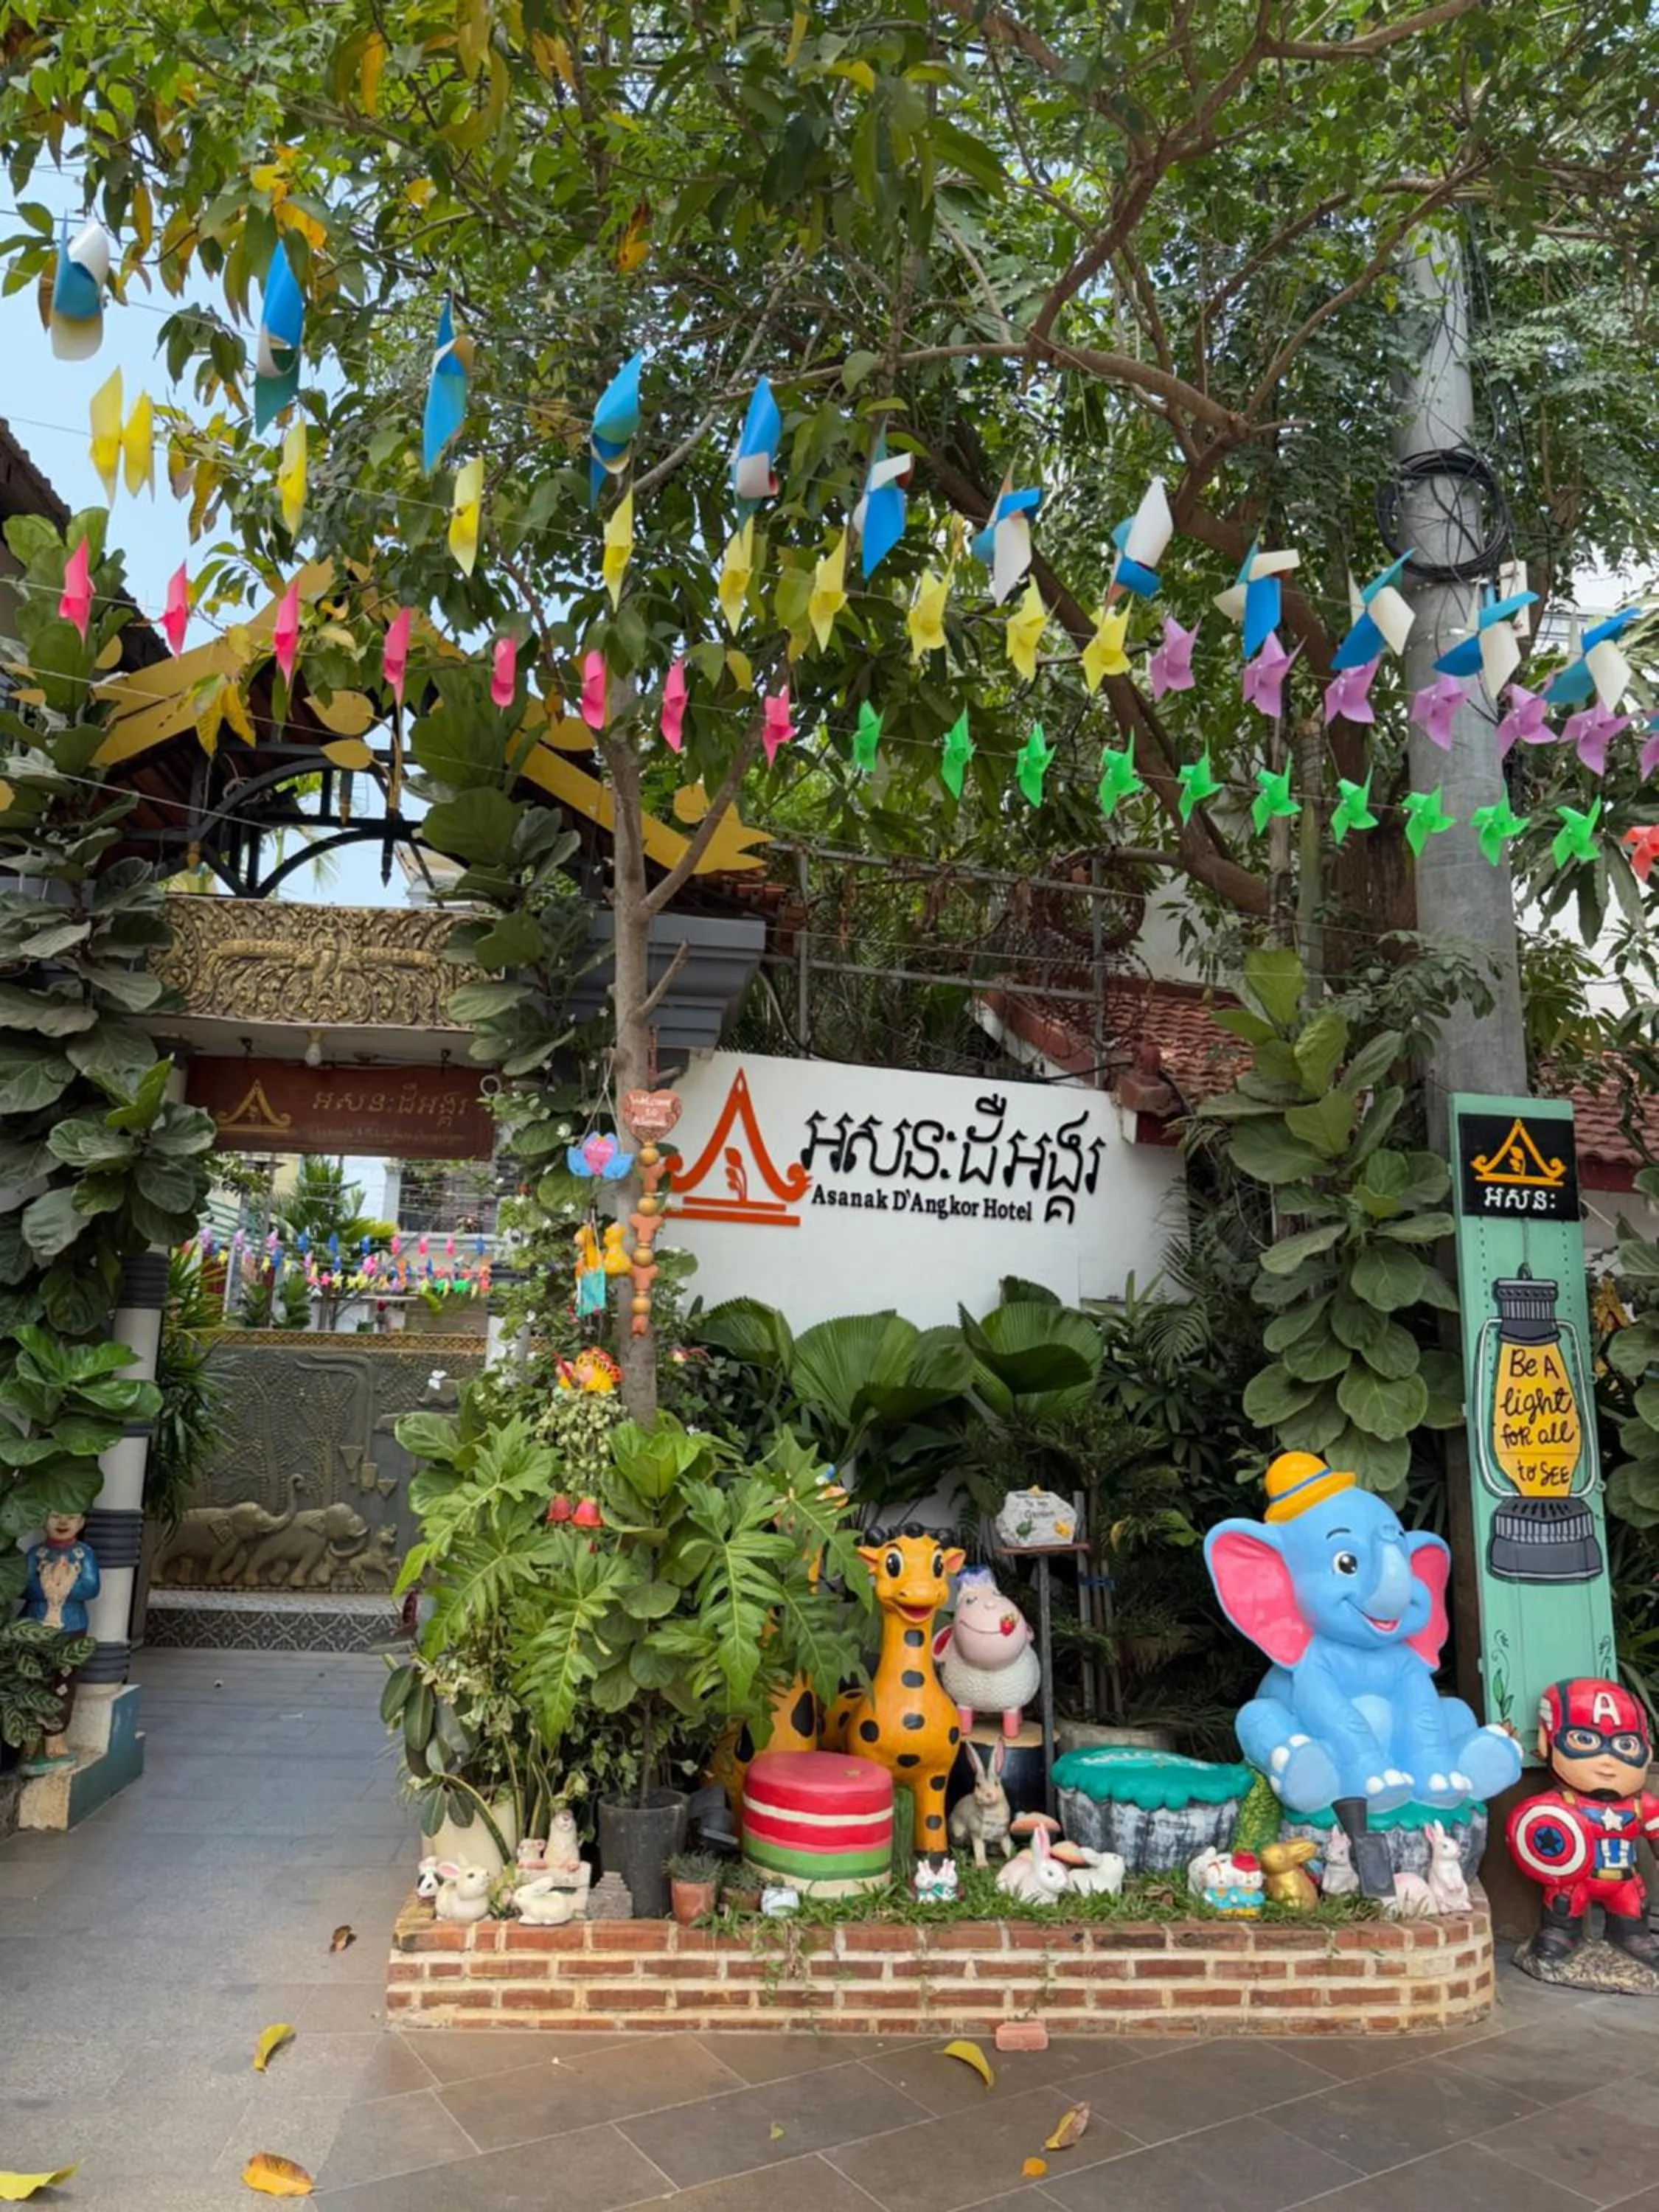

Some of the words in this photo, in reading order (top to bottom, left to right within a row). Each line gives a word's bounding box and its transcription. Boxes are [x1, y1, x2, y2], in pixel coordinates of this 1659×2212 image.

[812, 1183, 888, 1210] Asanak
[892, 1189, 979, 1220] D'Angkor
[983, 1197, 1032, 1222] Hotel
[1510, 1349, 1538, 1377] Be
[1544, 1354, 1559, 1380] A
[1499, 1387, 1573, 1425] light
[1537, 1420, 1575, 1444] all
[1517, 1458, 1537, 1482] to
[1593, 1692, 1621, 1727] A
